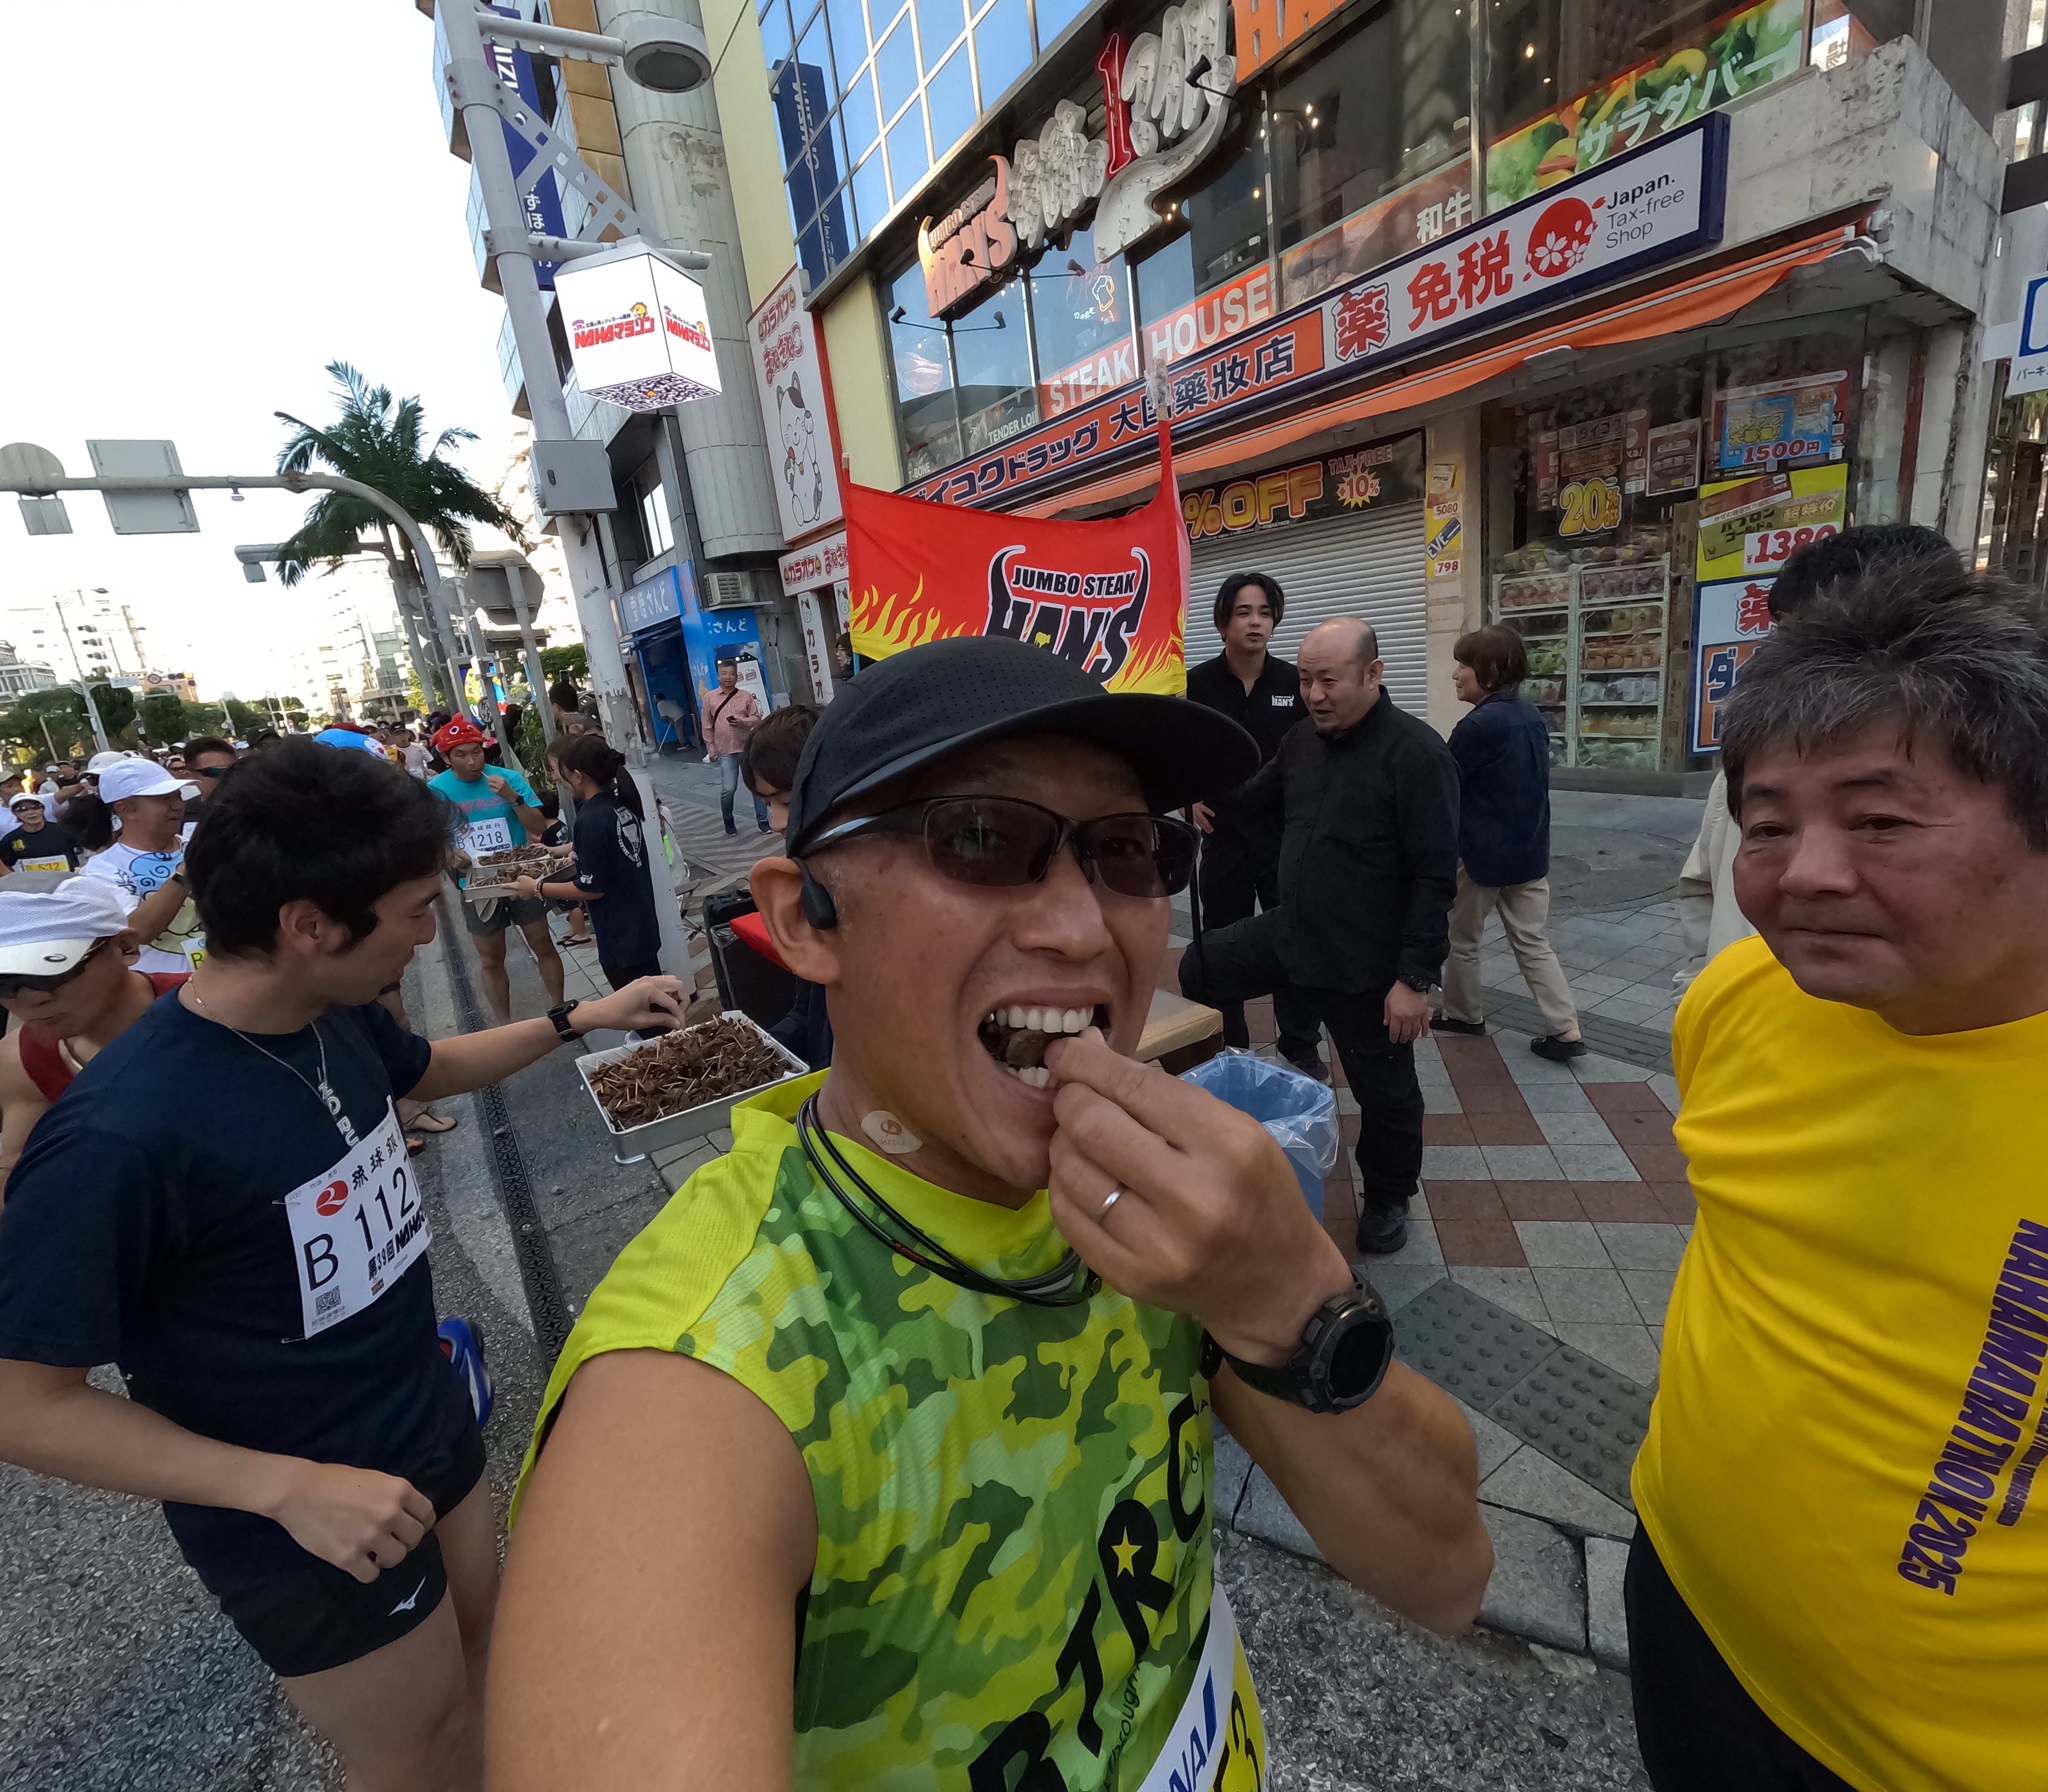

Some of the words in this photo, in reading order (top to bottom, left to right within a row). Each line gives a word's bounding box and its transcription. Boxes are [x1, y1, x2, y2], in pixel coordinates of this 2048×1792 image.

[1579, 29, 1802, 163] サラダバー
[1606, 172, 1676, 210] Japan.
[1417, 193, 1472, 243] 和牛
[1606, 188, 1685, 230] Tax-free
[1605, 221, 1653, 249] Shop
[1407, 230, 1514, 331] 免税
[1050, 343, 1135, 414] STEAK
[1151, 271, 1270, 362] HOUSE
[2016, 363, 2048, 381] パーキ
[988, 422, 1020, 444] TENDER
[909, 420, 1099, 503] イコクドラッグ
[1328, 444, 1393, 476] TAX-FREE
[1743, 440, 1821, 463] 1500円
[908, 462, 931, 481] T-BONE
[1339, 472, 1379, 499] +10%
[1011, 566, 1081, 595] JUMBO
[1083, 569, 1137, 598] STEAK
[1437, 561, 1459, 573] 798
[469, 831, 503, 848] 1218
[352, 1132, 399, 1191] 琉球銀
[303, 1234, 339, 1291] B
[354, 1167, 415, 1252] 112
